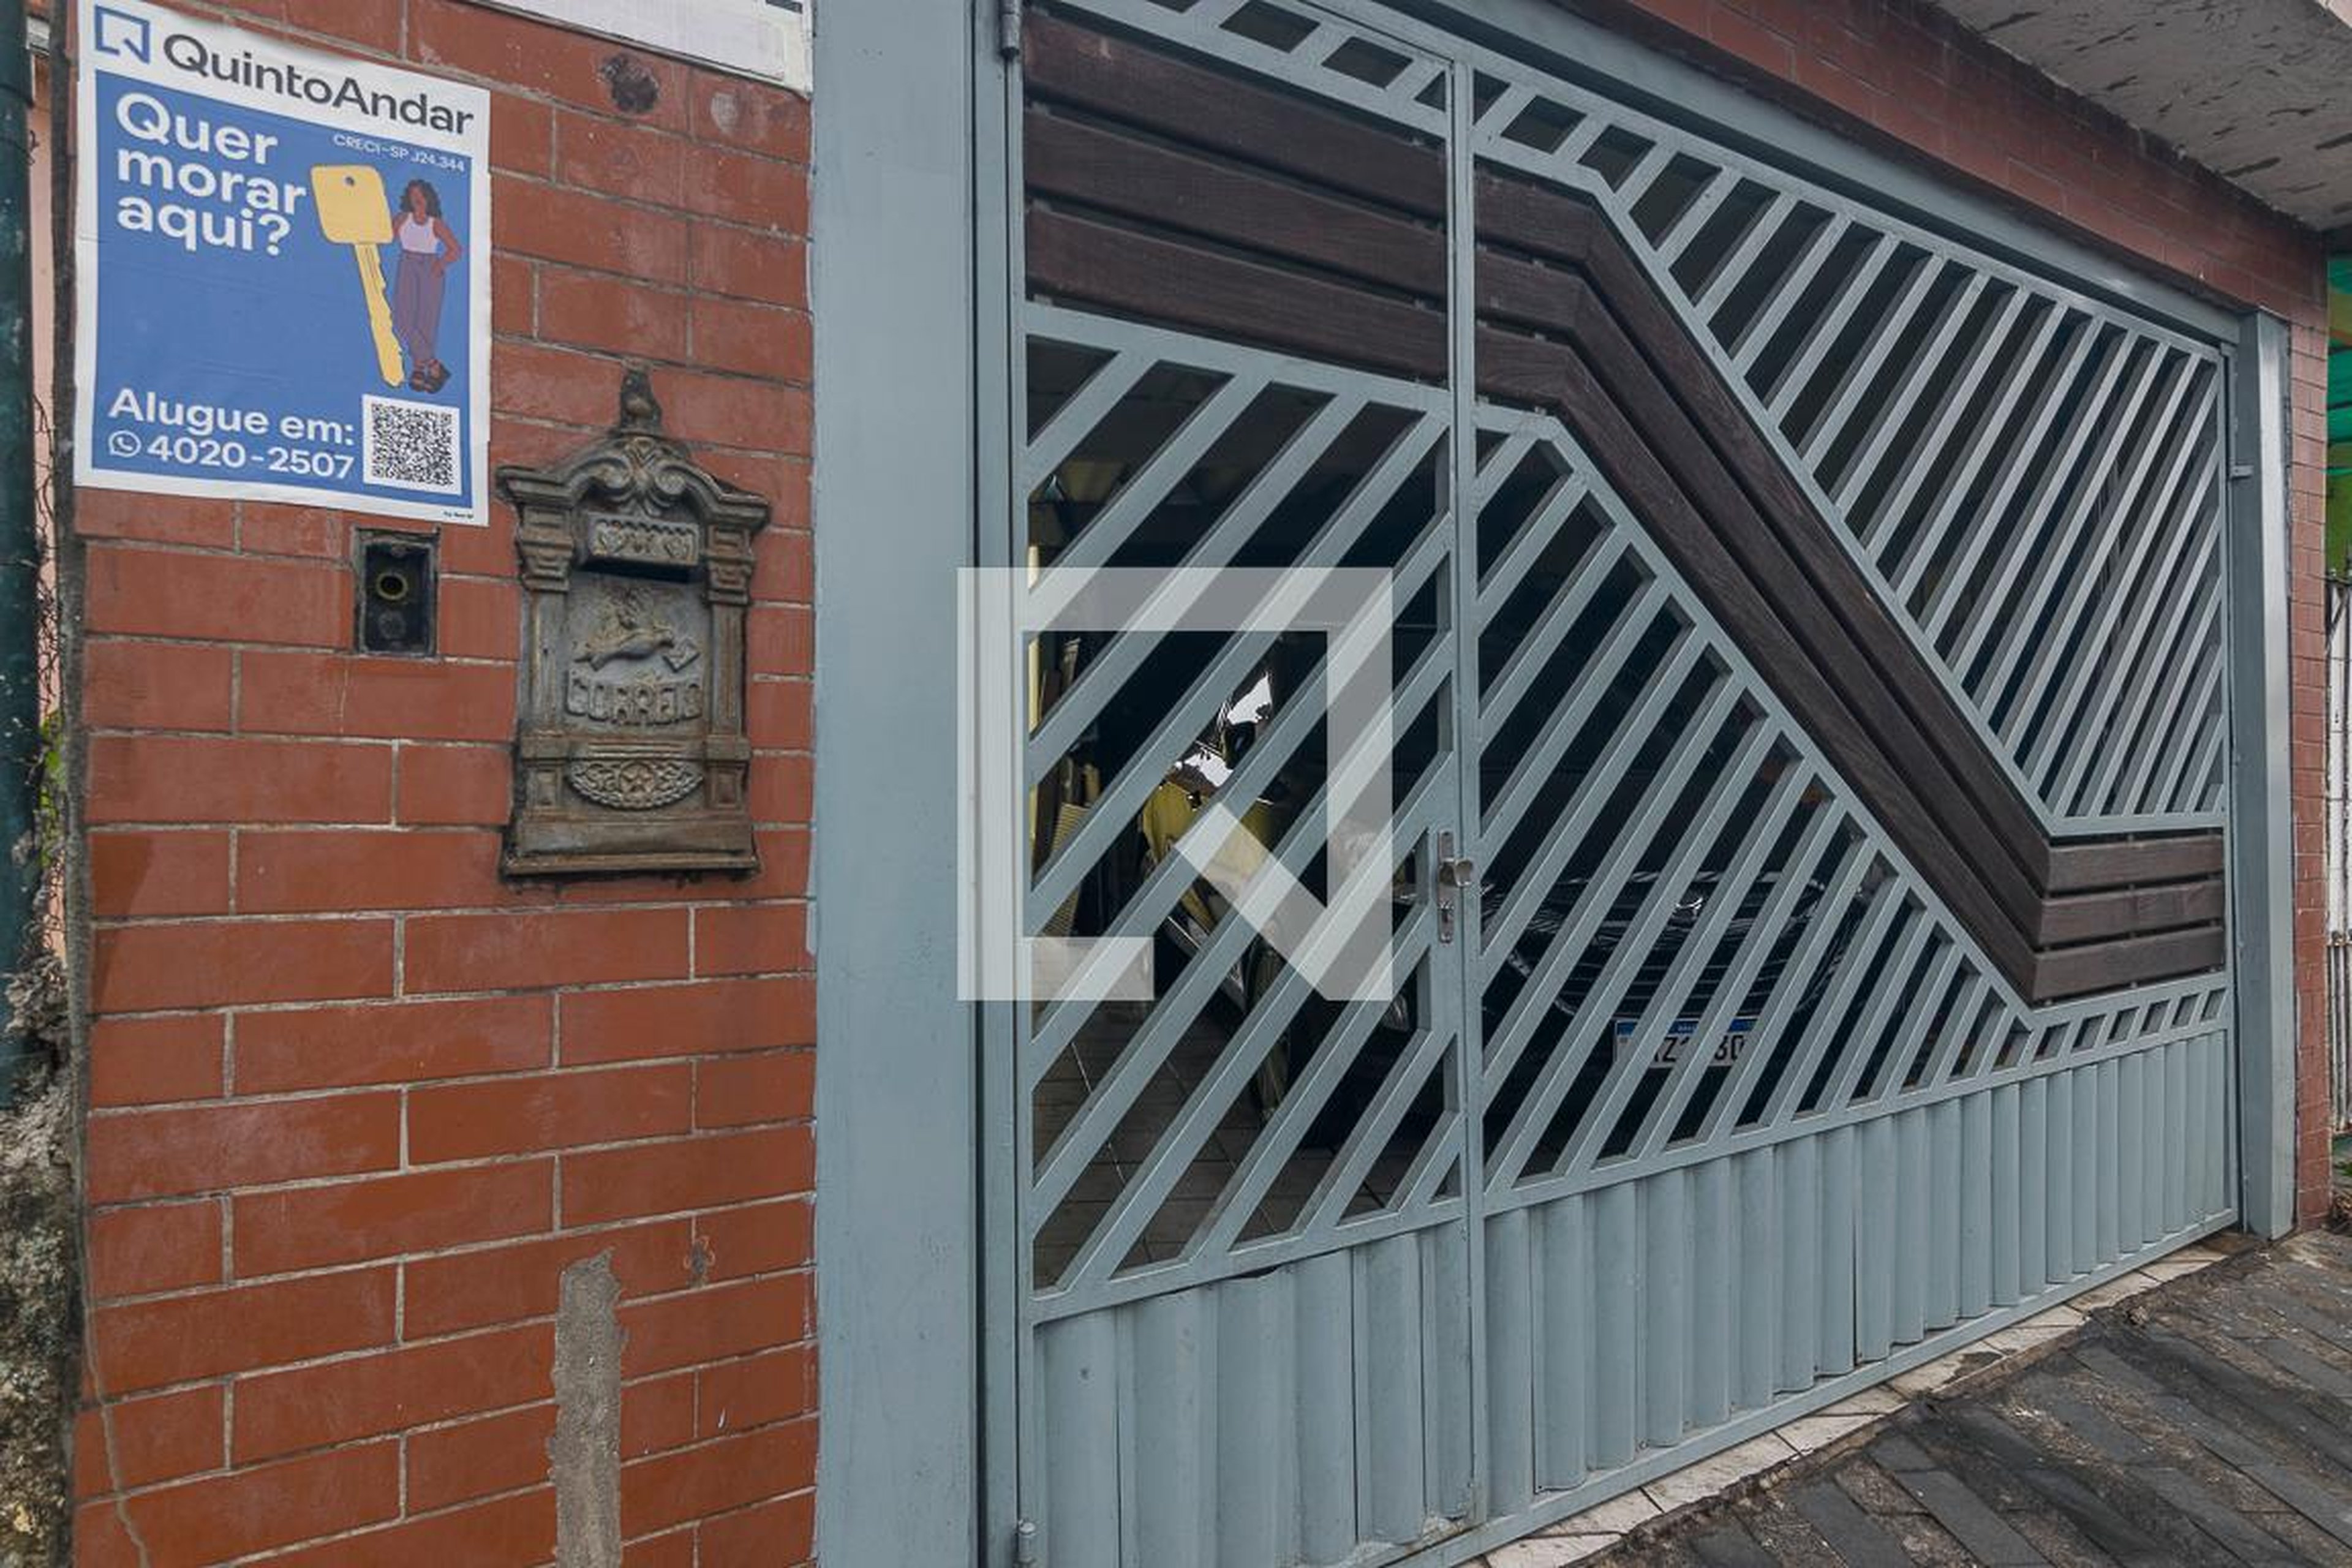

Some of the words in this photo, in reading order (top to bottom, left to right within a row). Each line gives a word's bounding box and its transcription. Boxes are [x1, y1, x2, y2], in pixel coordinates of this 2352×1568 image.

[163, 34, 474, 134] QuintoAndar
[116, 93, 277, 164] Quer
[334, 134, 409, 159] CRECI-SP
[410, 151, 464, 172] J24.344
[118, 149, 306, 214] morar
[118, 197, 290, 255] aqui?
[108, 388, 269, 436] Alugue
[280, 415, 354, 445] em:
[147, 435, 355, 479] 4020-2507
